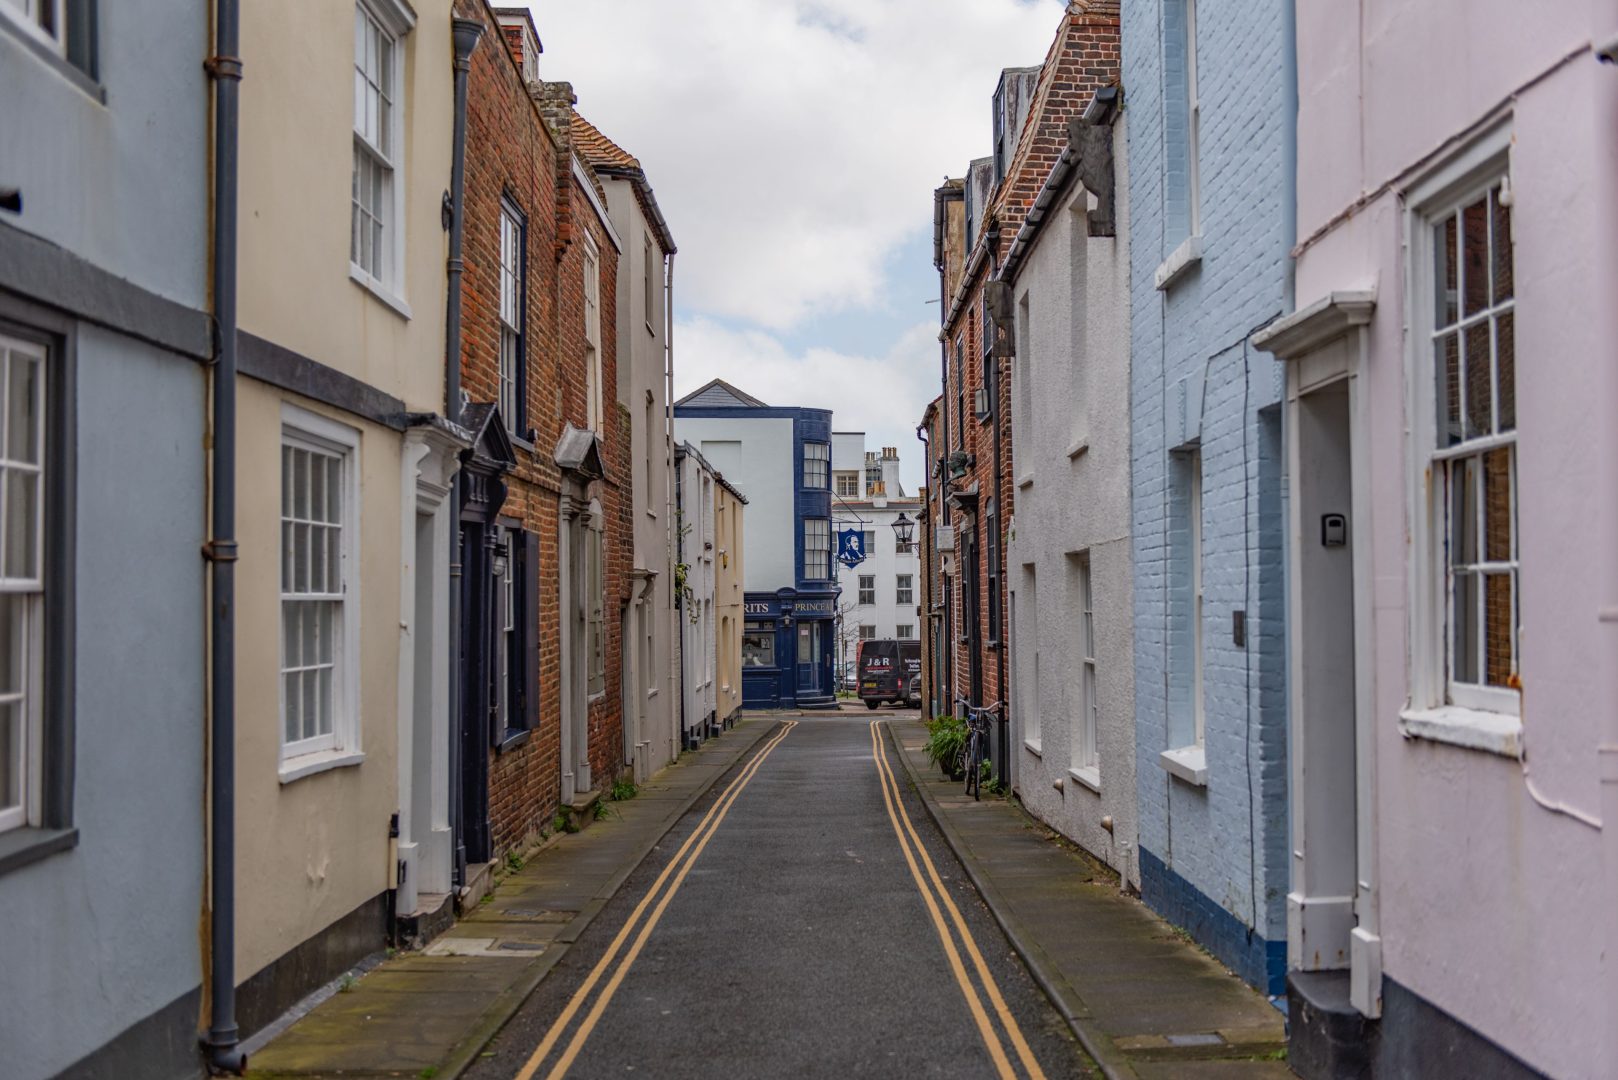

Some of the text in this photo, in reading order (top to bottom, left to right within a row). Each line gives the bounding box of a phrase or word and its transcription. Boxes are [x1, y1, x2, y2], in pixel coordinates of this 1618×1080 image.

[795, 603, 825, 611] PRINCE
[867, 657, 890, 666] J & R
